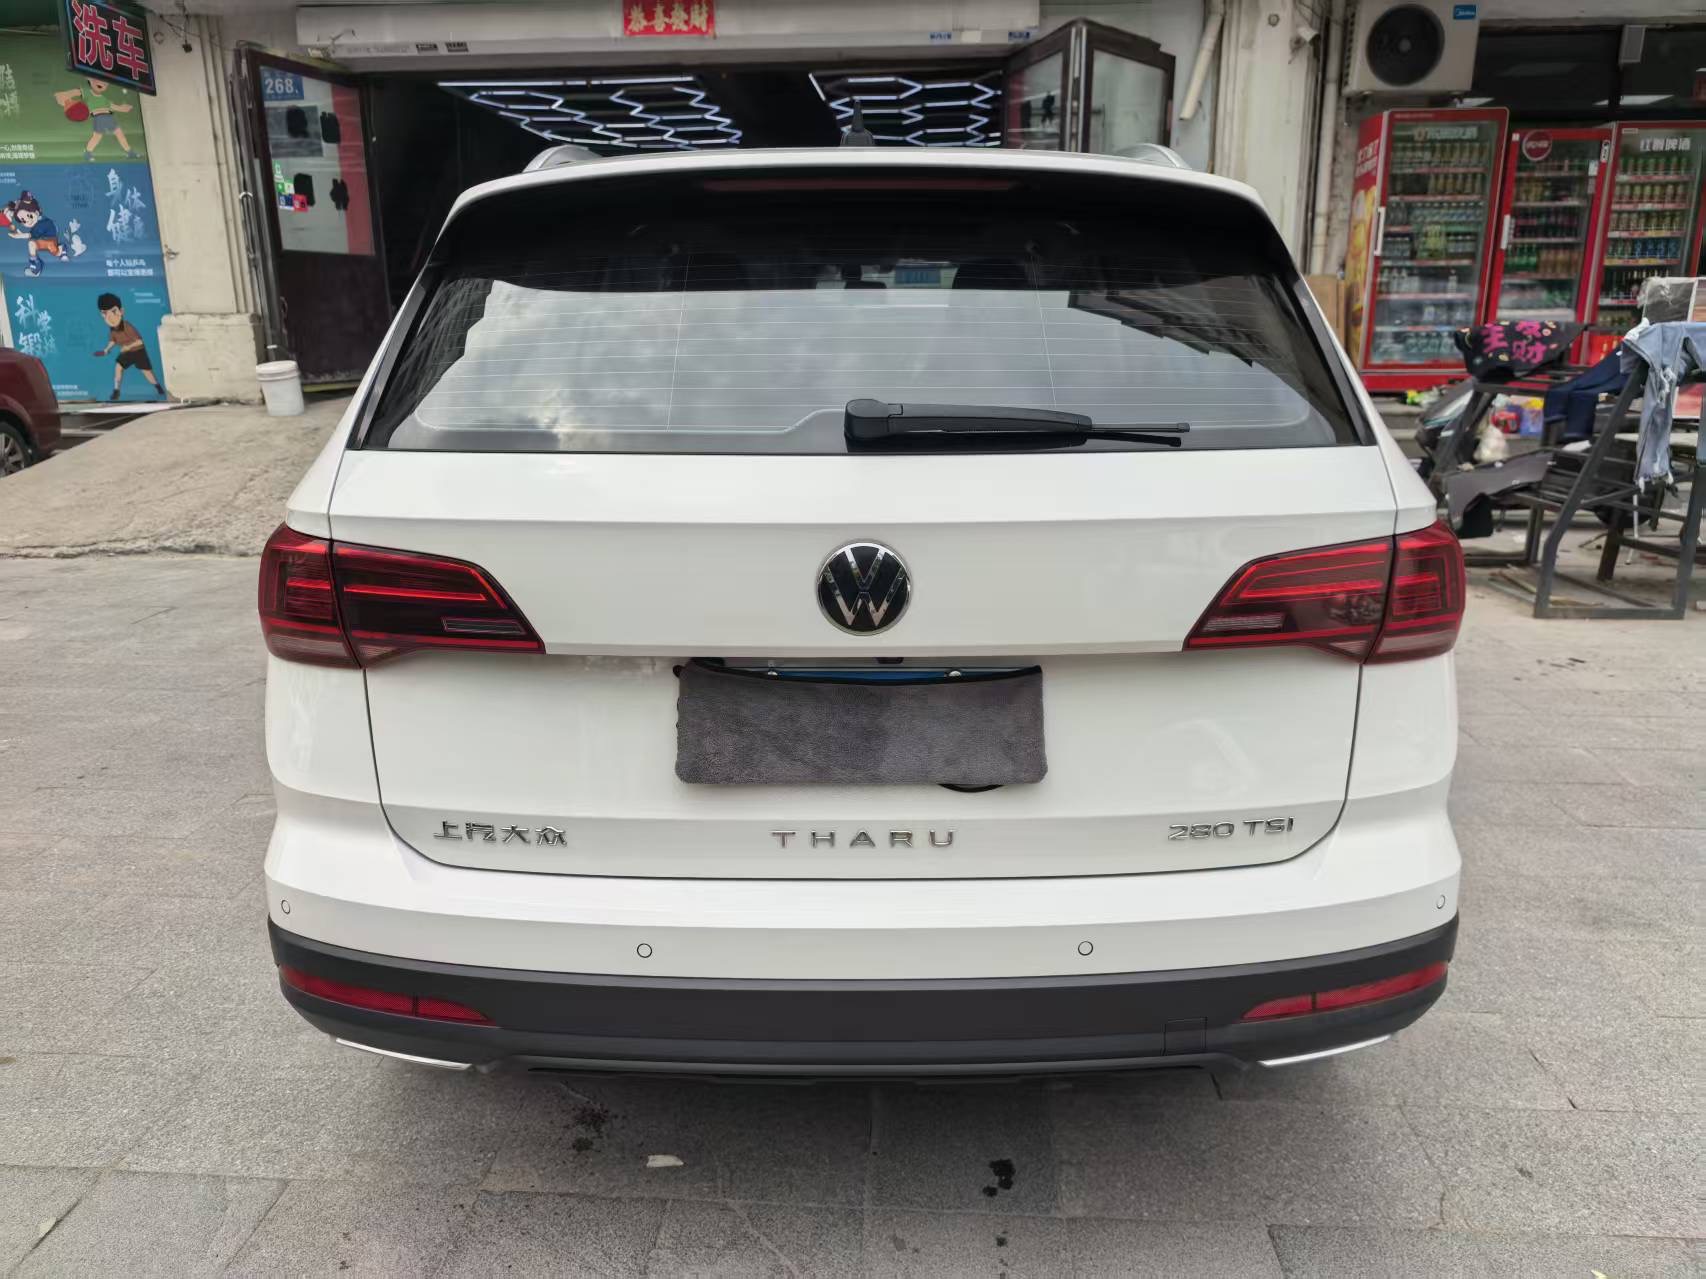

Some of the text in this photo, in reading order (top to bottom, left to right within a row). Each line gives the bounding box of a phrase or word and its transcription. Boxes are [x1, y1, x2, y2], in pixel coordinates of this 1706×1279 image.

[72, 0, 149, 80] 洗车
[433, 821, 567, 846] 上汽大众
[770, 830, 956, 848] THARU
[1168, 816, 1294, 840] 280 TSI
